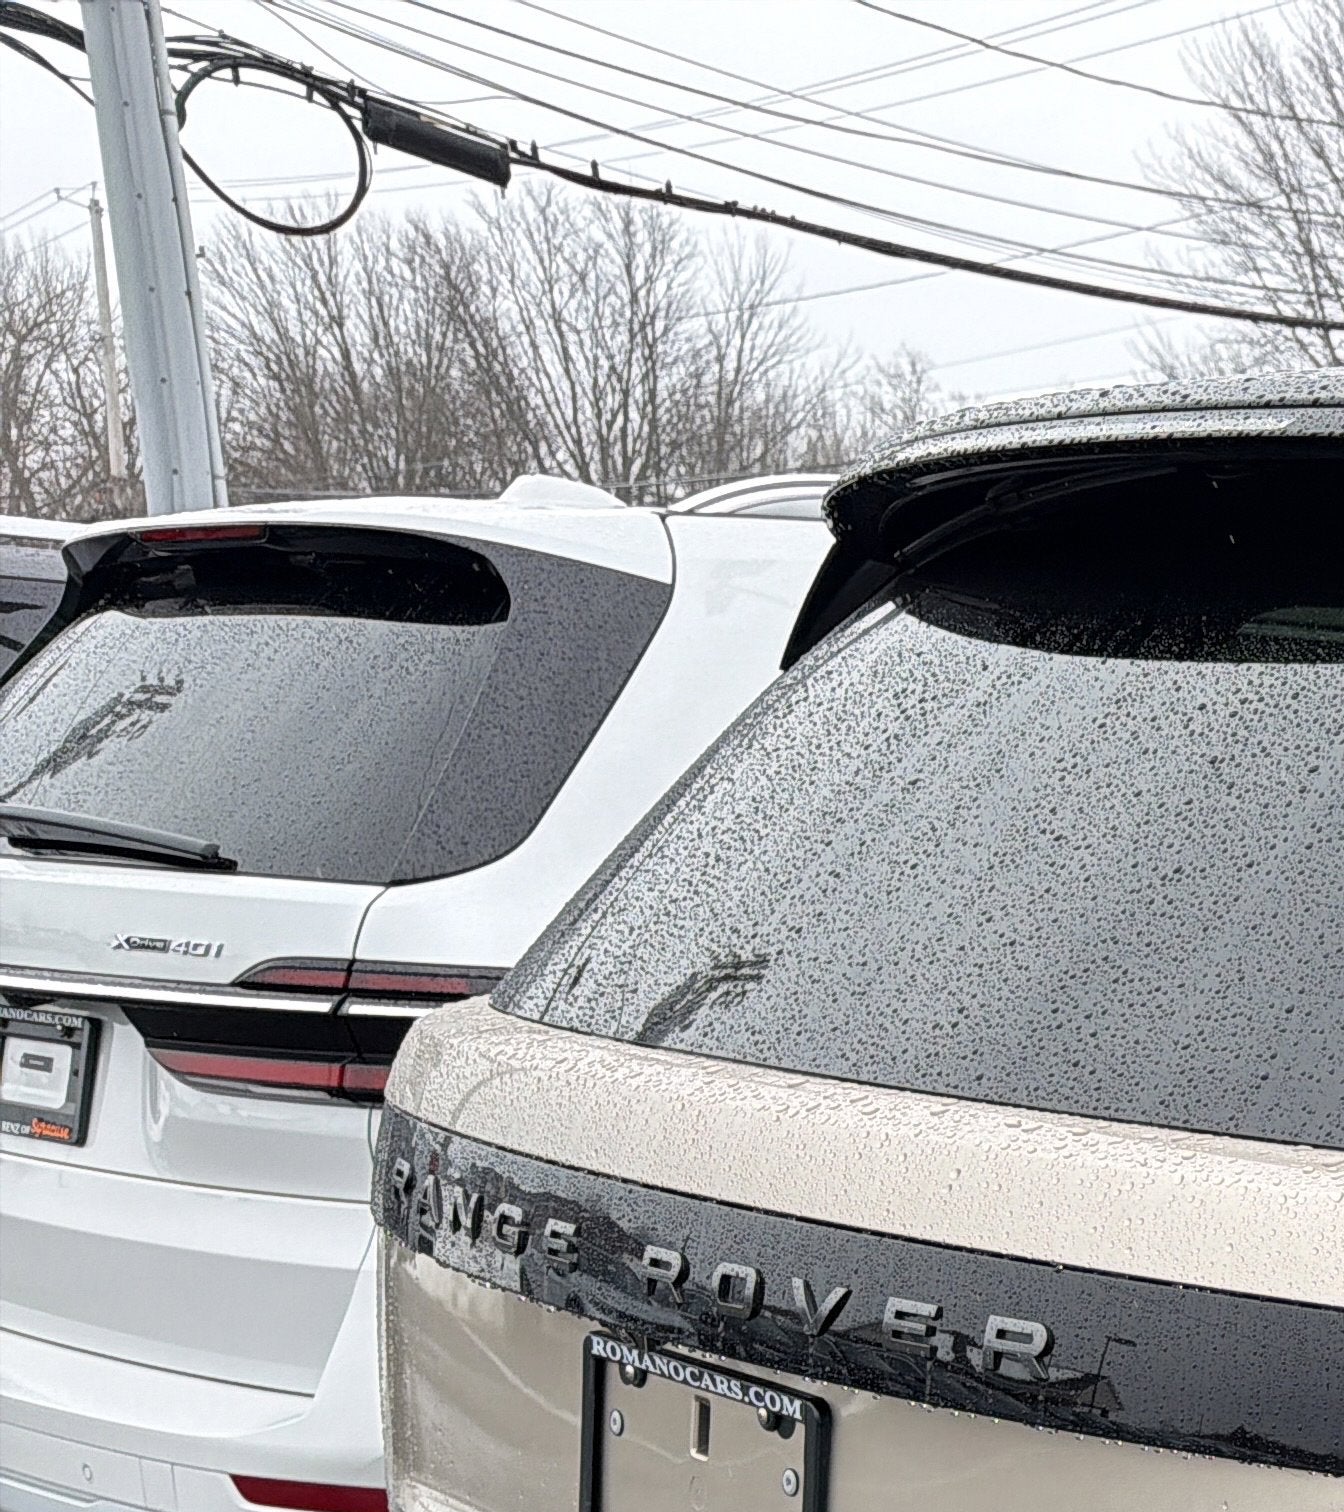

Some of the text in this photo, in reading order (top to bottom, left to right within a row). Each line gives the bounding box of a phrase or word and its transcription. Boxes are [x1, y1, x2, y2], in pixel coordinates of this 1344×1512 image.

[391, 1157, 1053, 1381] RANGE ROVER
[590, 1336, 803, 1421] ROMANOCARS.COM
